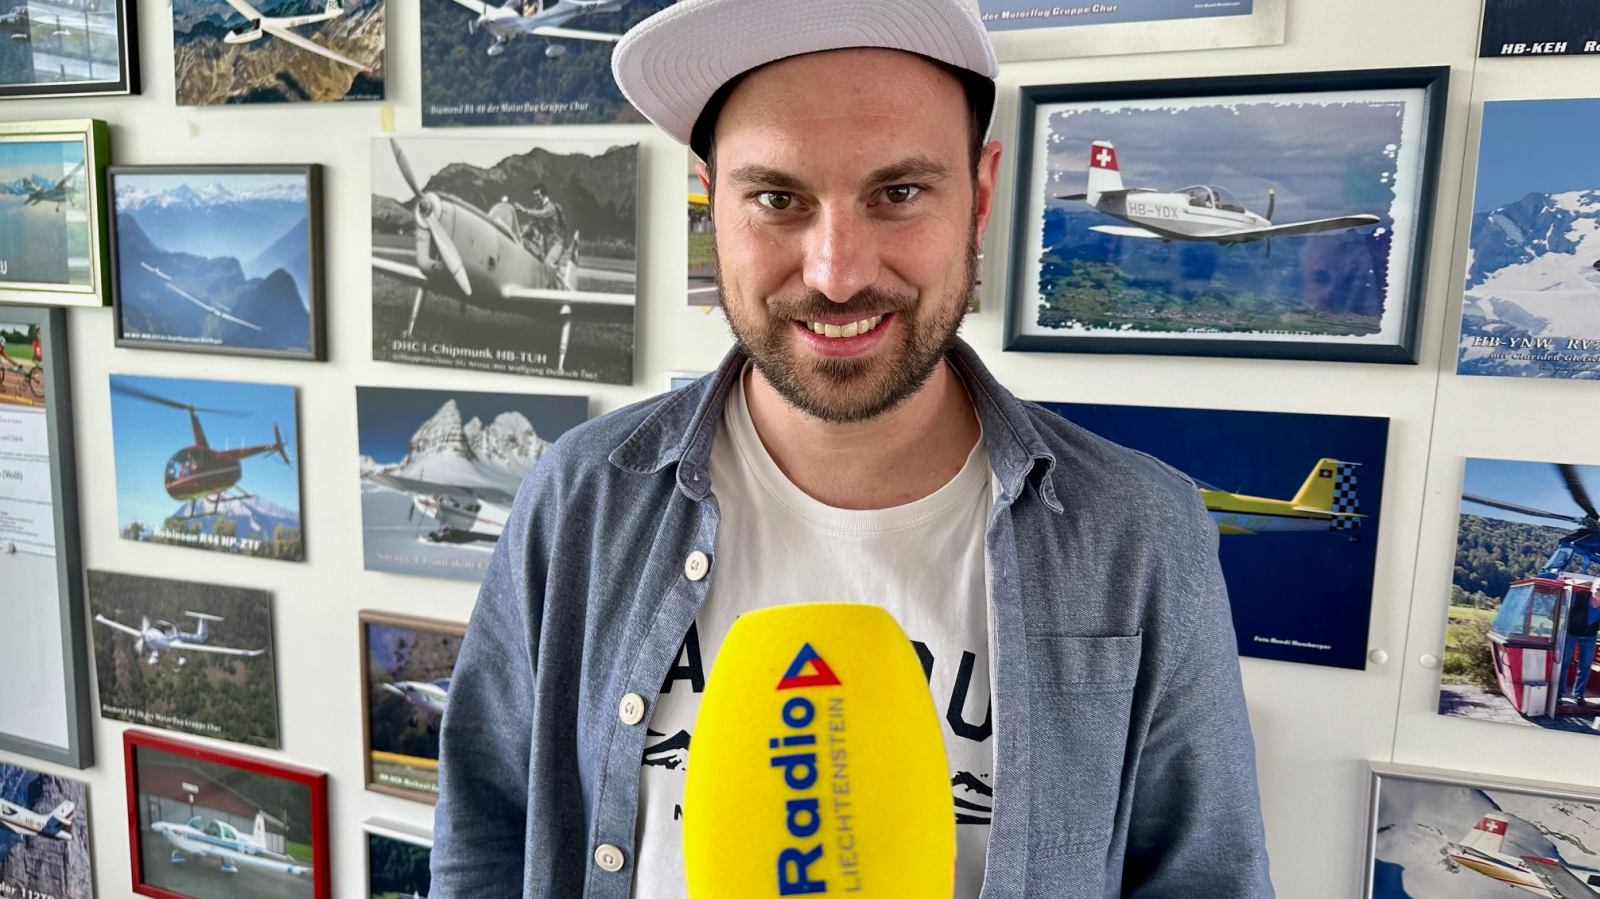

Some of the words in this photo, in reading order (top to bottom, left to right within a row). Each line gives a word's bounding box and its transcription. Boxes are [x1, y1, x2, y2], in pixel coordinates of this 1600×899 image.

[982, 13, 998, 21] der
[1000, 9, 1050, 20] Motorflug
[1052, 6, 1090, 16] Gruppe
[1092, 3, 1118, 13] Chur
[1500, 41, 1568, 55] HB-KEH
[430, 103, 463, 115] Diamond
[501, 101, 538, 113] Motorflug
[540, 101, 568, 114] Gruppe
[569, 100, 589, 112] Chur
[1472, 336, 1553, 349] HB-YNW
[495, 349, 547, 365] HB-TUH
[153, 527, 198, 543] Robinson
[199, 532, 220, 546] R44
[768, 695, 828, 897] Radio
[828, 697, 861, 893] LIECHTENSTEIN
